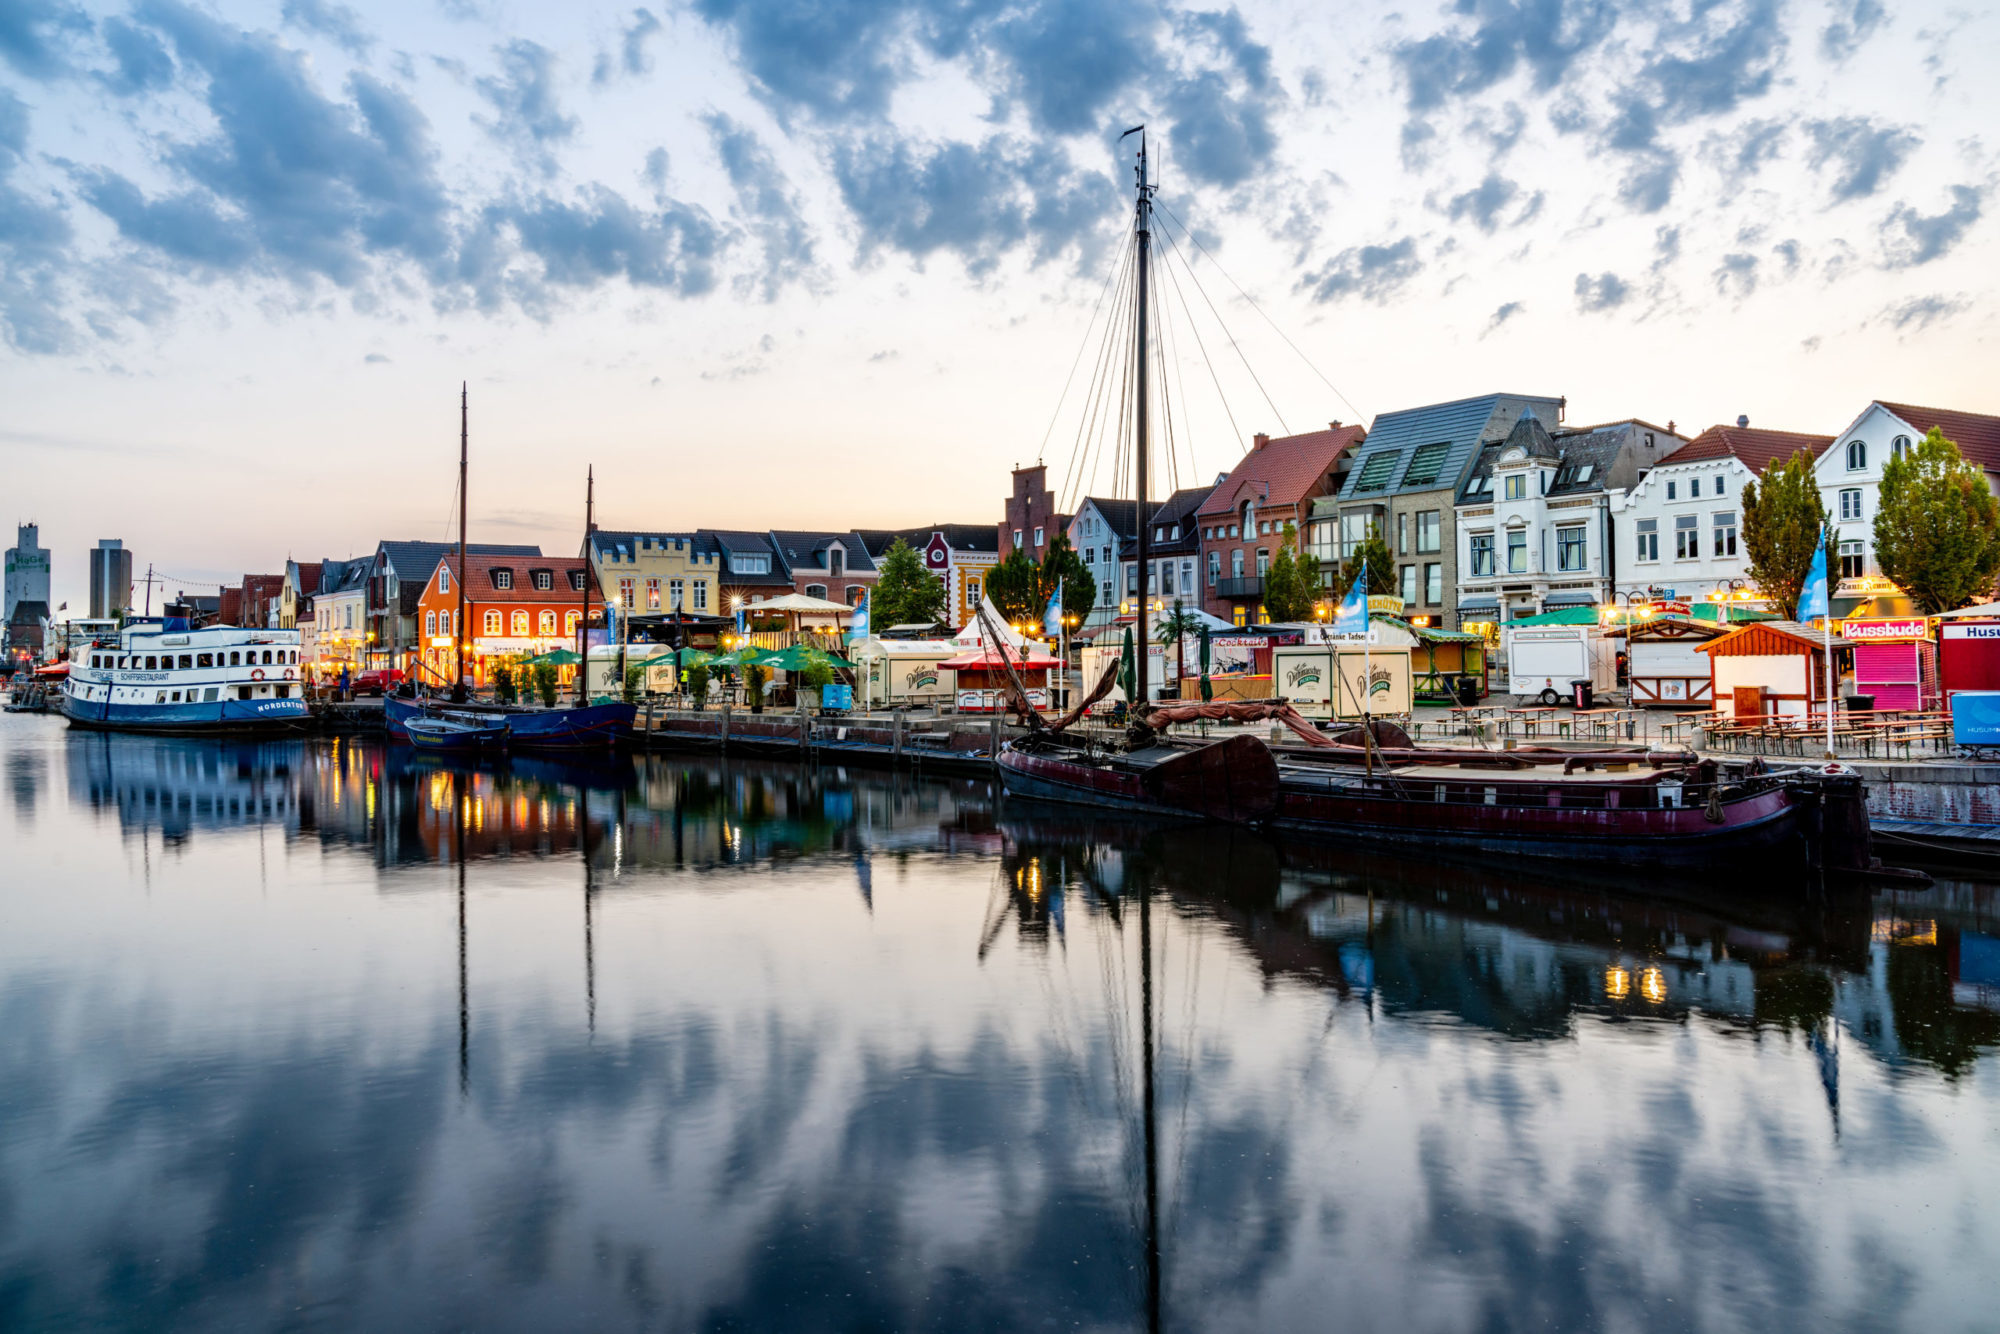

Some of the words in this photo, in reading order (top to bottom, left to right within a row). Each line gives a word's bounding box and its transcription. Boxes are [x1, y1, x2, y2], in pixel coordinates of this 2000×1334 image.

[1845, 622, 1923, 637] Kussbude
[1218, 636, 1267, 647] Cocktails
[1320, 632, 1346, 641] Gtränke
[120, 672, 170, 681] SCHIFFSRESTAURANT
